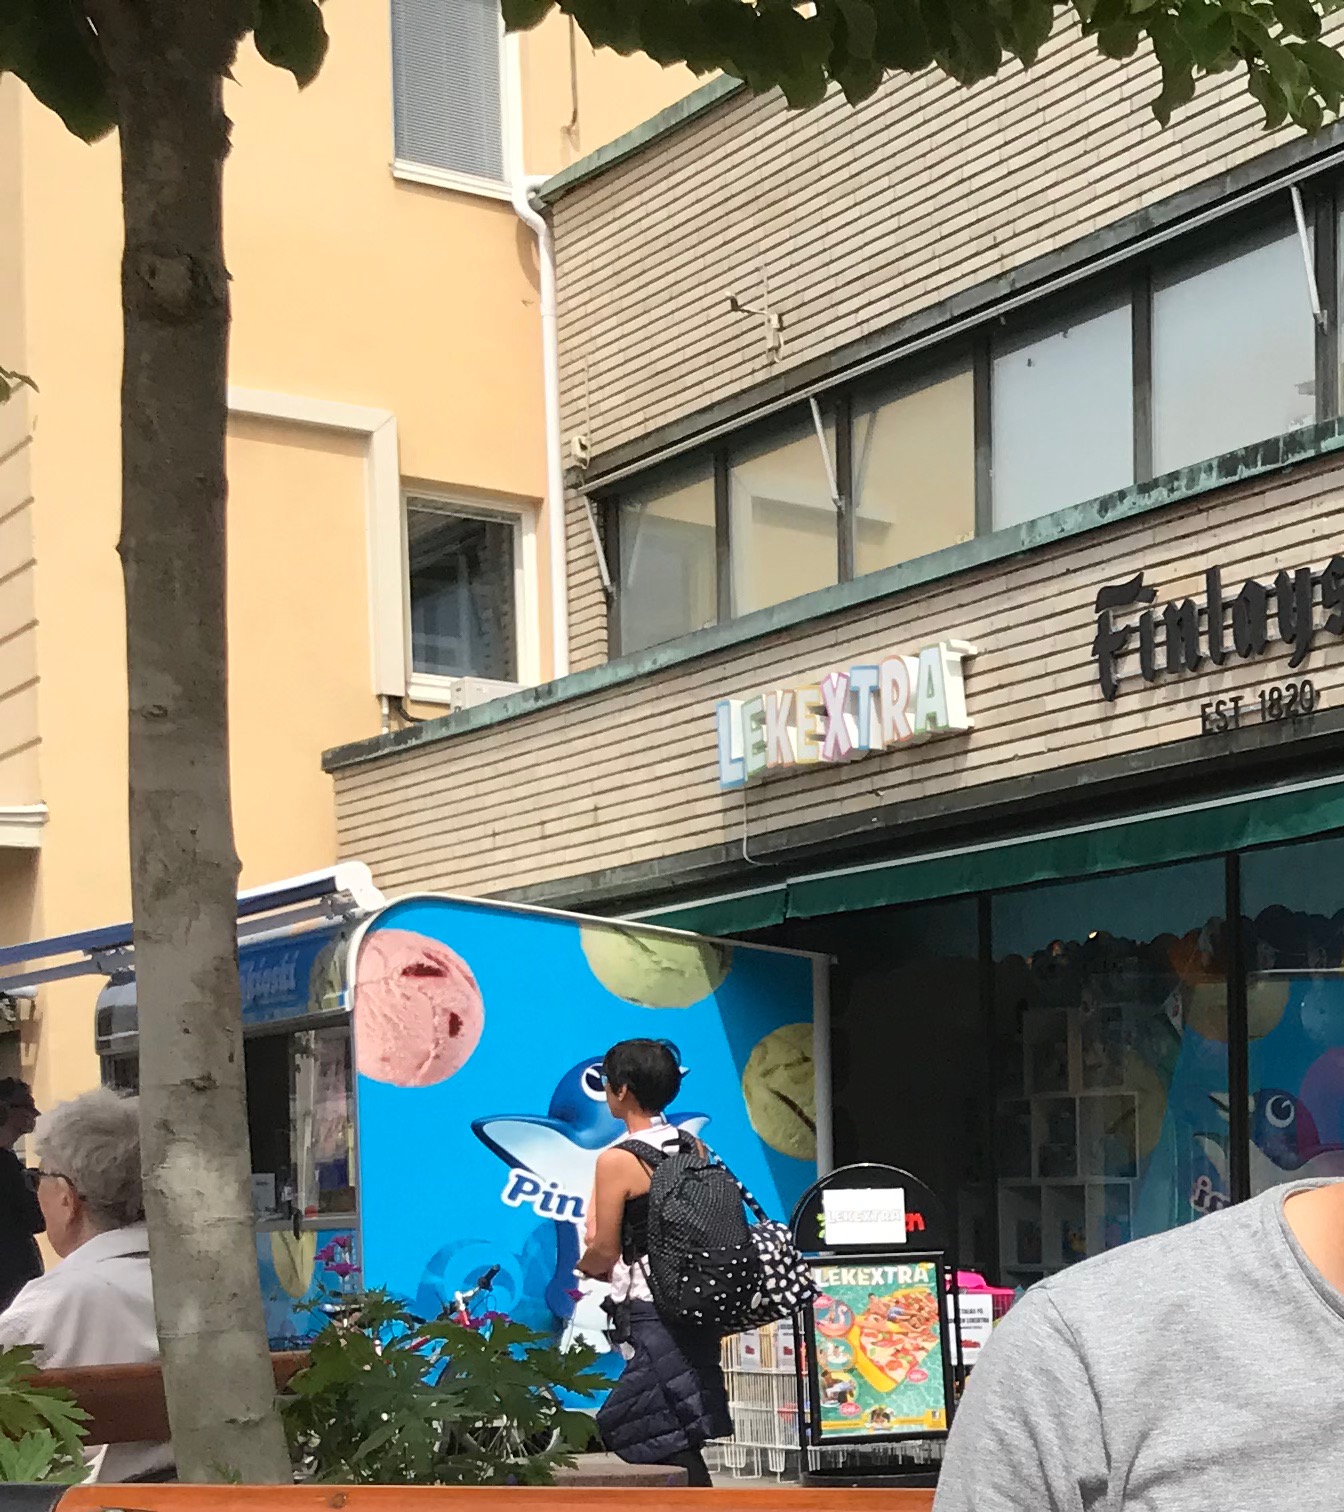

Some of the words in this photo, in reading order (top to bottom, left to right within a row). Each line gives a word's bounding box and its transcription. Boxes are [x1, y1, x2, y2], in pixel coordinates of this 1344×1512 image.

[715, 640, 962, 790] LEKEXTRA
[1201, 695, 1247, 735] EST
[1257, 679, 1320, 723] 1820
[505, 1171, 587, 1221] Pin
[814, 1264, 929, 1288] LEKEXTRA
